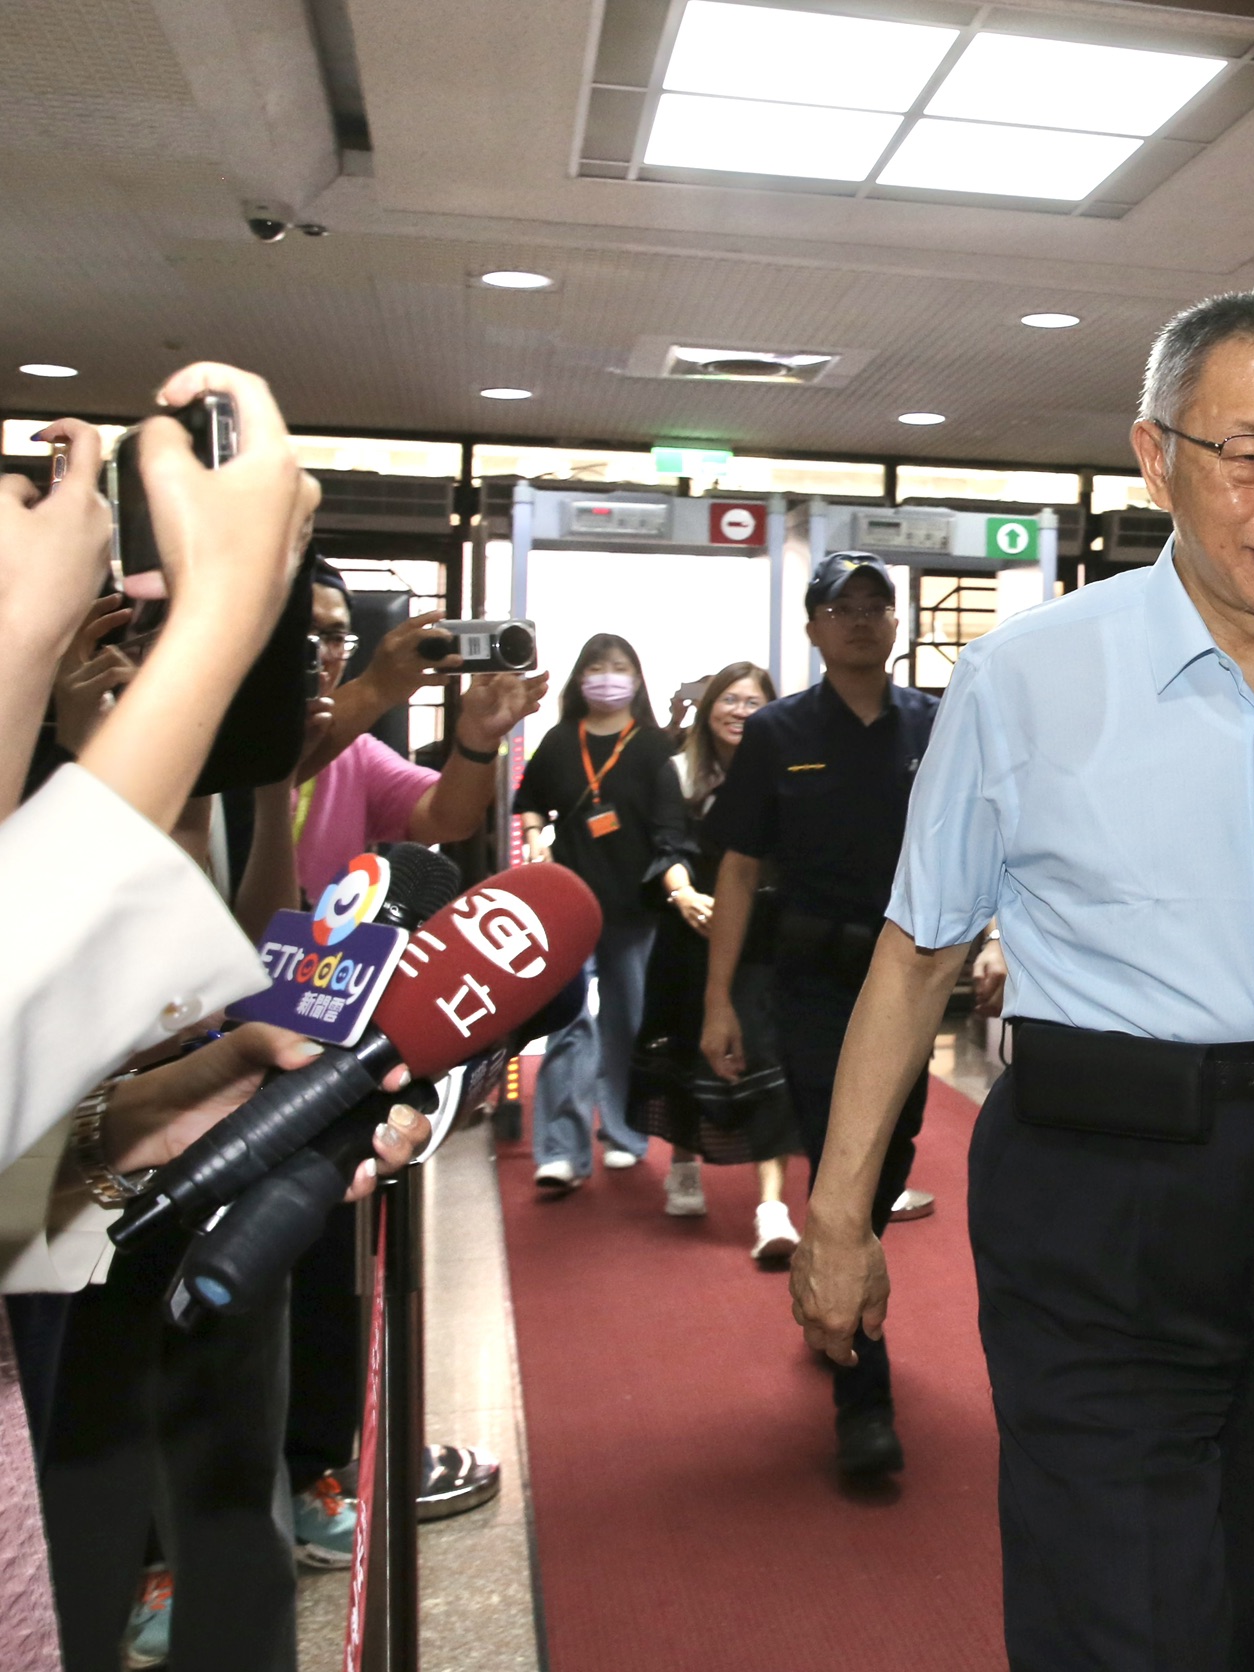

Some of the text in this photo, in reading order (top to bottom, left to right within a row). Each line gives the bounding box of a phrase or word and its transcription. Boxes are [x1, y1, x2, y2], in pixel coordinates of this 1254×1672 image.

[260, 942, 375, 1005] ETtoday
[296, 991, 346, 1023] 新聞雲
